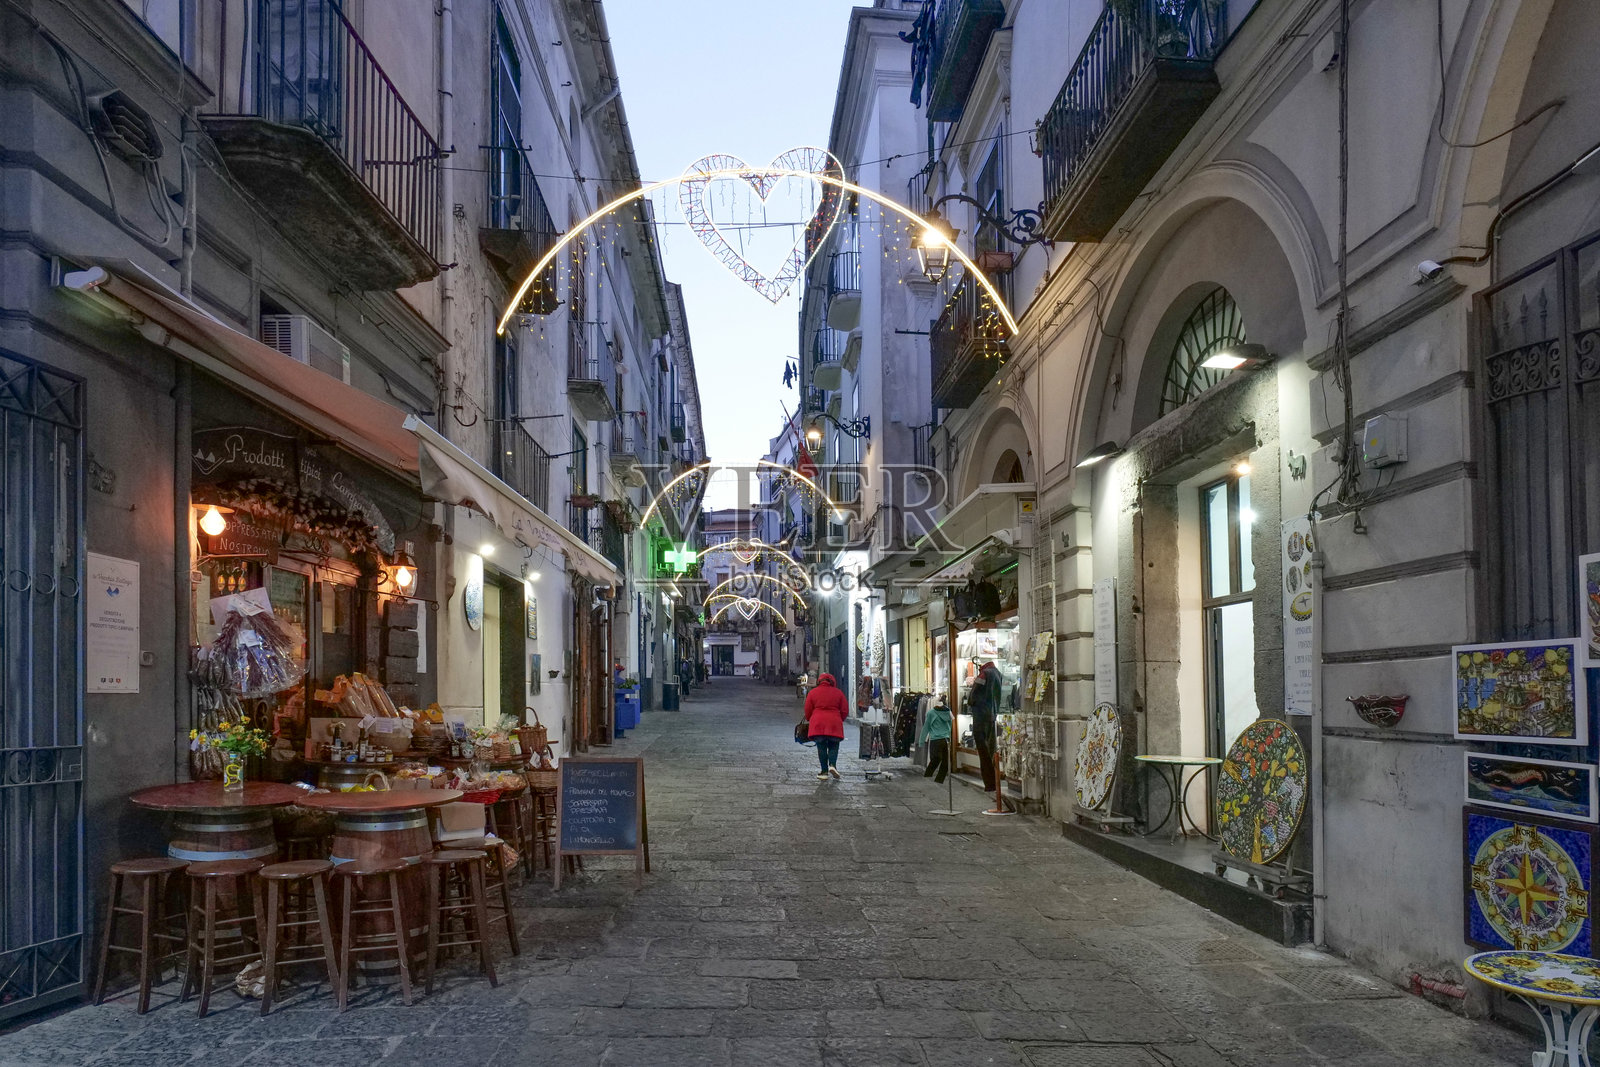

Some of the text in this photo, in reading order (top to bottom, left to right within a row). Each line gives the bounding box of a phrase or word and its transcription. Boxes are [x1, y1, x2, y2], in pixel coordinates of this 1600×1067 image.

[225, 434, 285, 468] Prodotti
[300, 458, 321, 482] tipici
[225, 521, 277, 539] OPPRESSATA
